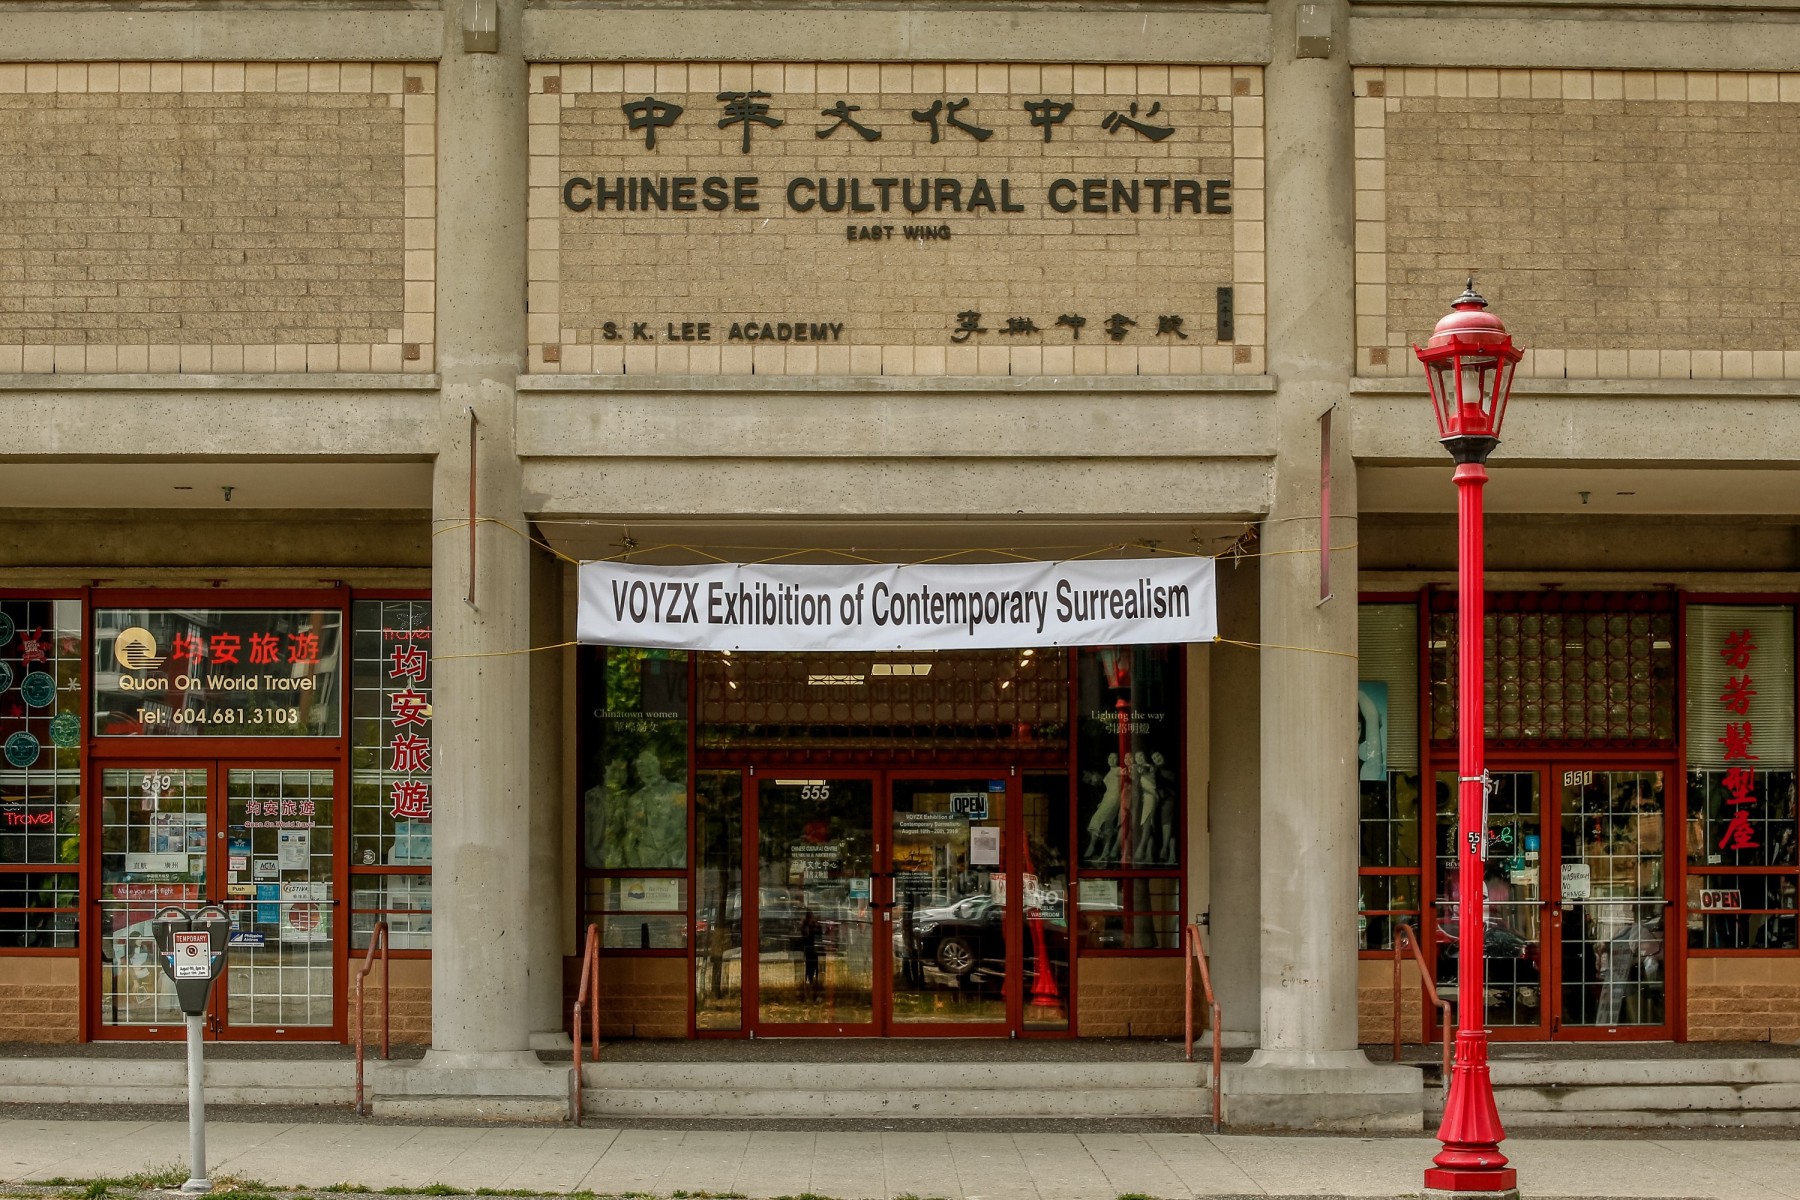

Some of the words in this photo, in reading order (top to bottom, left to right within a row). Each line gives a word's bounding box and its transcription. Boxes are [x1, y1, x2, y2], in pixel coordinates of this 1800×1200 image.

[622, 89, 1175, 153] 中華文化中心
[563, 176, 760, 212] CHINESE
[787, 177, 1024, 213] CULTURAL
[1048, 178, 1232, 214] CENTRE
[846, 225, 894, 240] EAST
[904, 225, 951, 241] WING
[603, 322, 623, 341] S.
[633, 322, 654, 341] K.
[668, 322, 710, 341] LEE
[728, 322, 843, 341] ACADEMY
[611, 581, 699, 624] VOYZX
[707, 581, 832, 625] Exhibition
[840, 582, 865, 624] of
[872, 582, 1048, 636] Contemporary
[1055, 578, 1190, 624] Surrealism
[172, 632, 320, 665] 均安旅遊
[119, 674, 168, 693] Quon
[175, 674, 201, 691] On
[206, 674, 258, 691] World
[264, 675, 317, 691] Travel
[137, 708, 166, 725] Tel:
[173, 708, 298, 725] 604.681.3103
[593, 708, 642, 719] Chinatown
[646, 711, 678, 719] women
[1091, 710, 1129, 722] Lighting
[1131, 710, 1145, 720] the
[1147, 712, 1165, 722] way
[389, 645, 432, 819] 均安旅遊
[142, 774, 171, 791] 559
[1564, 771, 1592, 787] 551
[801, 785, 830, 800] 555
[953, 797, 985, 813] OPEN
[3, 810, 54, 825] Travel
[1702, 892, 1740, 907] OPEN
